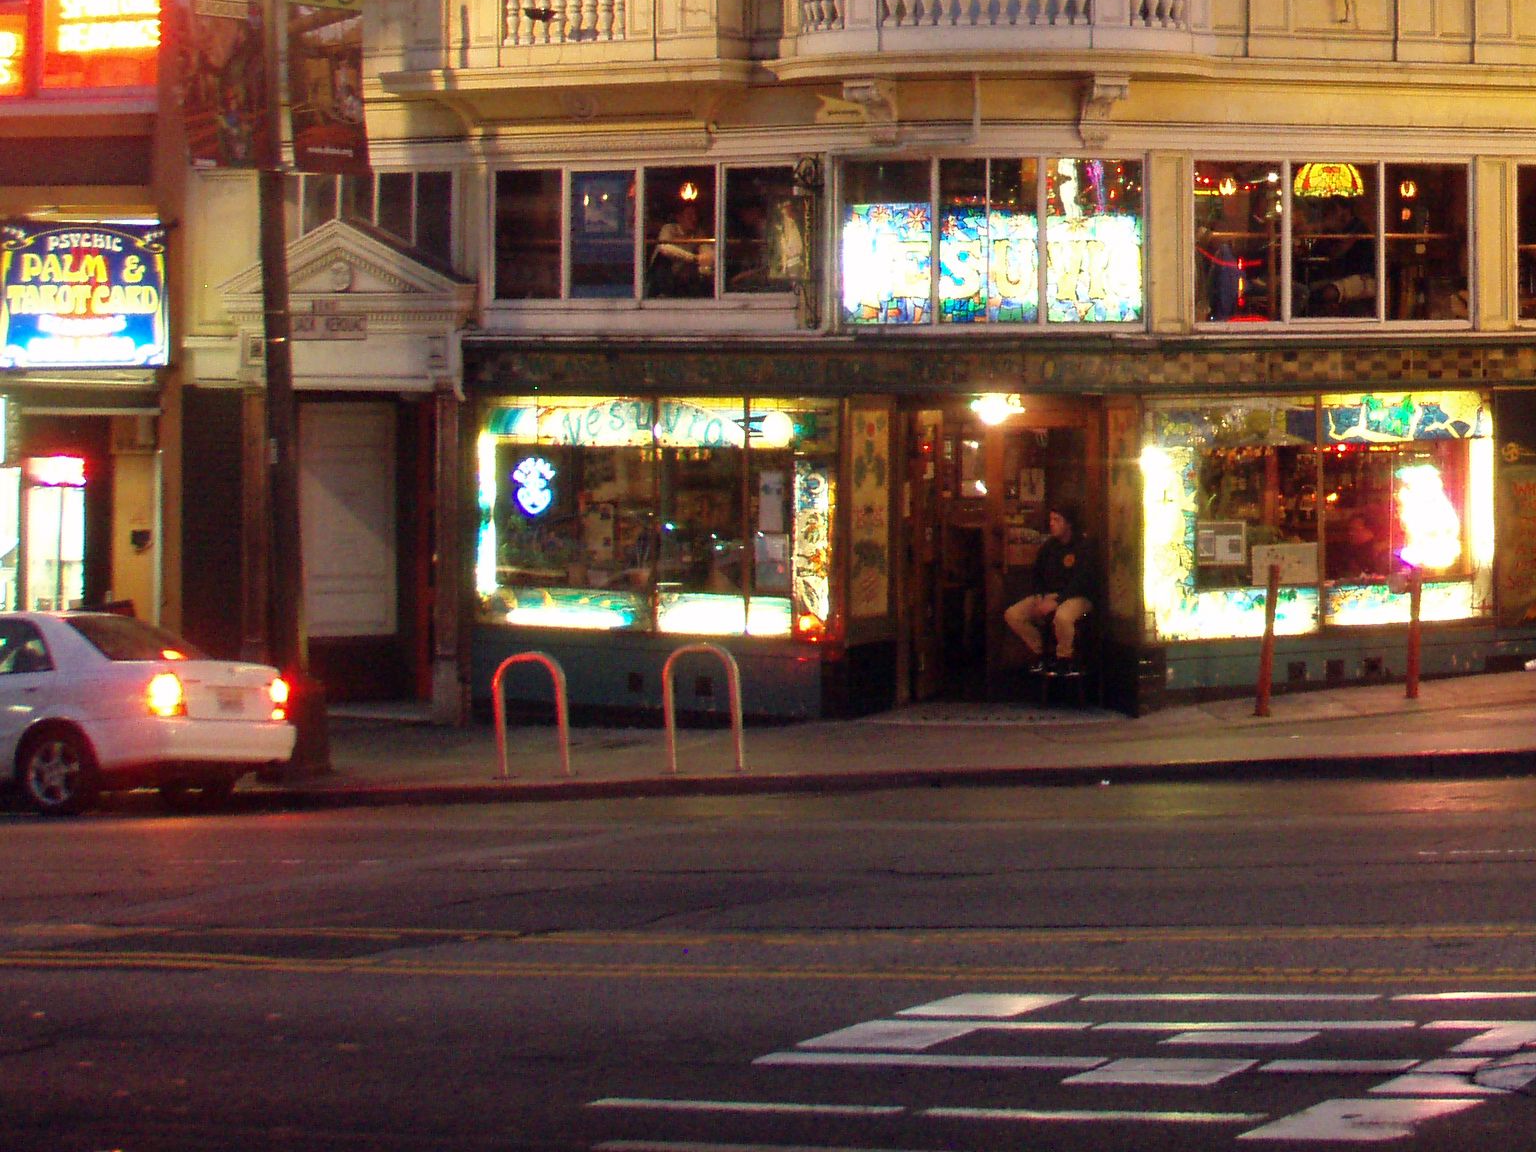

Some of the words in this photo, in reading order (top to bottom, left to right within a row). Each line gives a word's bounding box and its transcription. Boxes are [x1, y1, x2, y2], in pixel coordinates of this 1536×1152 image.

[47, 233, 123, 252] PSYCHIC
[21, 253, 108, 283] PALM
[122, 255, 146, 283] &
[7, 285, 92, 315] TAROT
[91, 285, 158, 315] CARD
